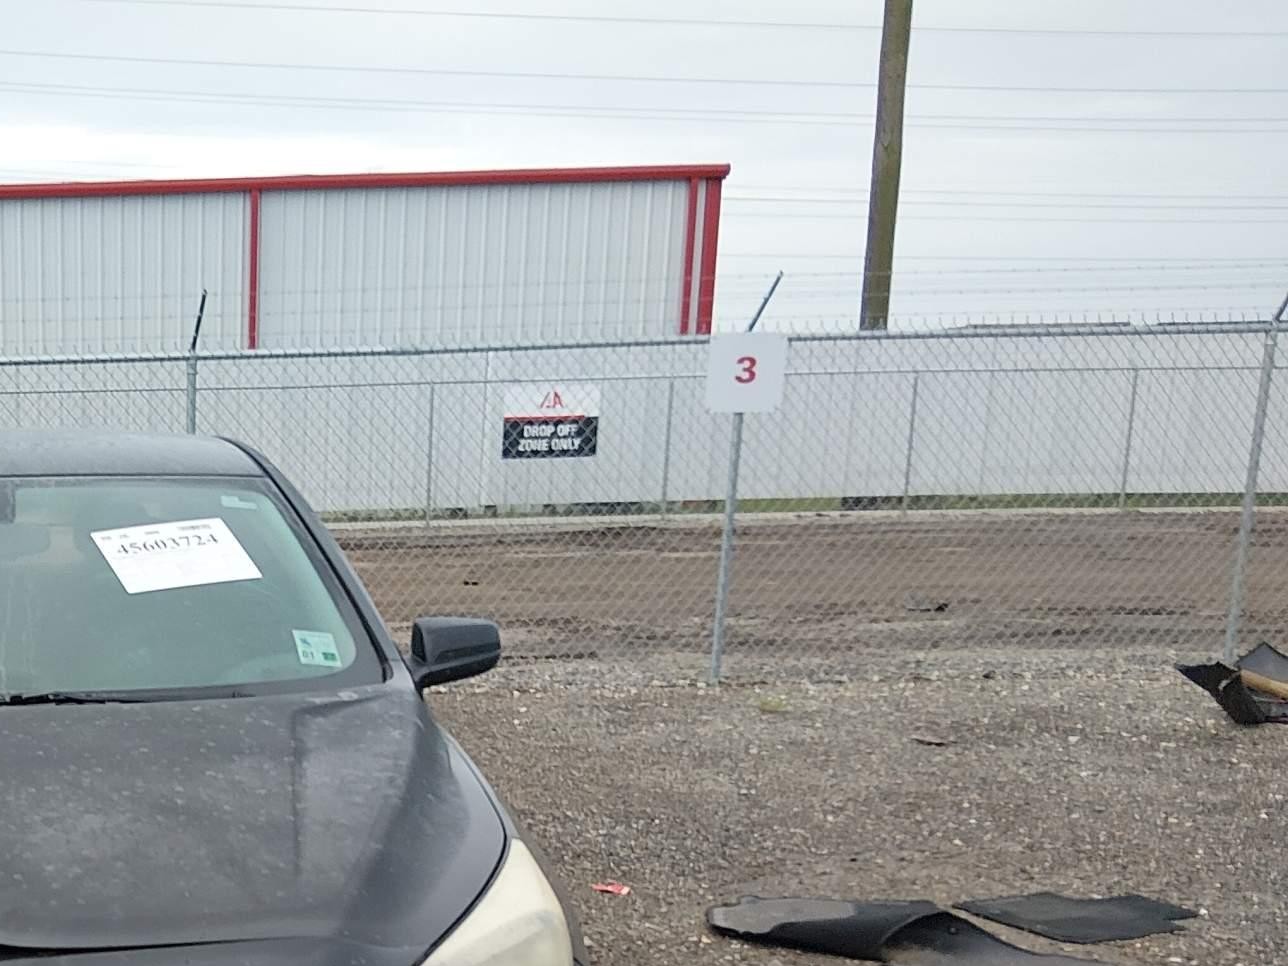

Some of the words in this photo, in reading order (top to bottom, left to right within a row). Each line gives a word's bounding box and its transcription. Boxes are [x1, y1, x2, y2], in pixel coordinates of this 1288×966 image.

[735, 356, 757, 384] 3
[523, 423, 555, 438] DROP
[556, 423, 579, 437] OFF
[518, 438, 549, 451] ZONE
[550, 438, 582, 450] ONLY
[117, 533, 218, 554] 45603724
